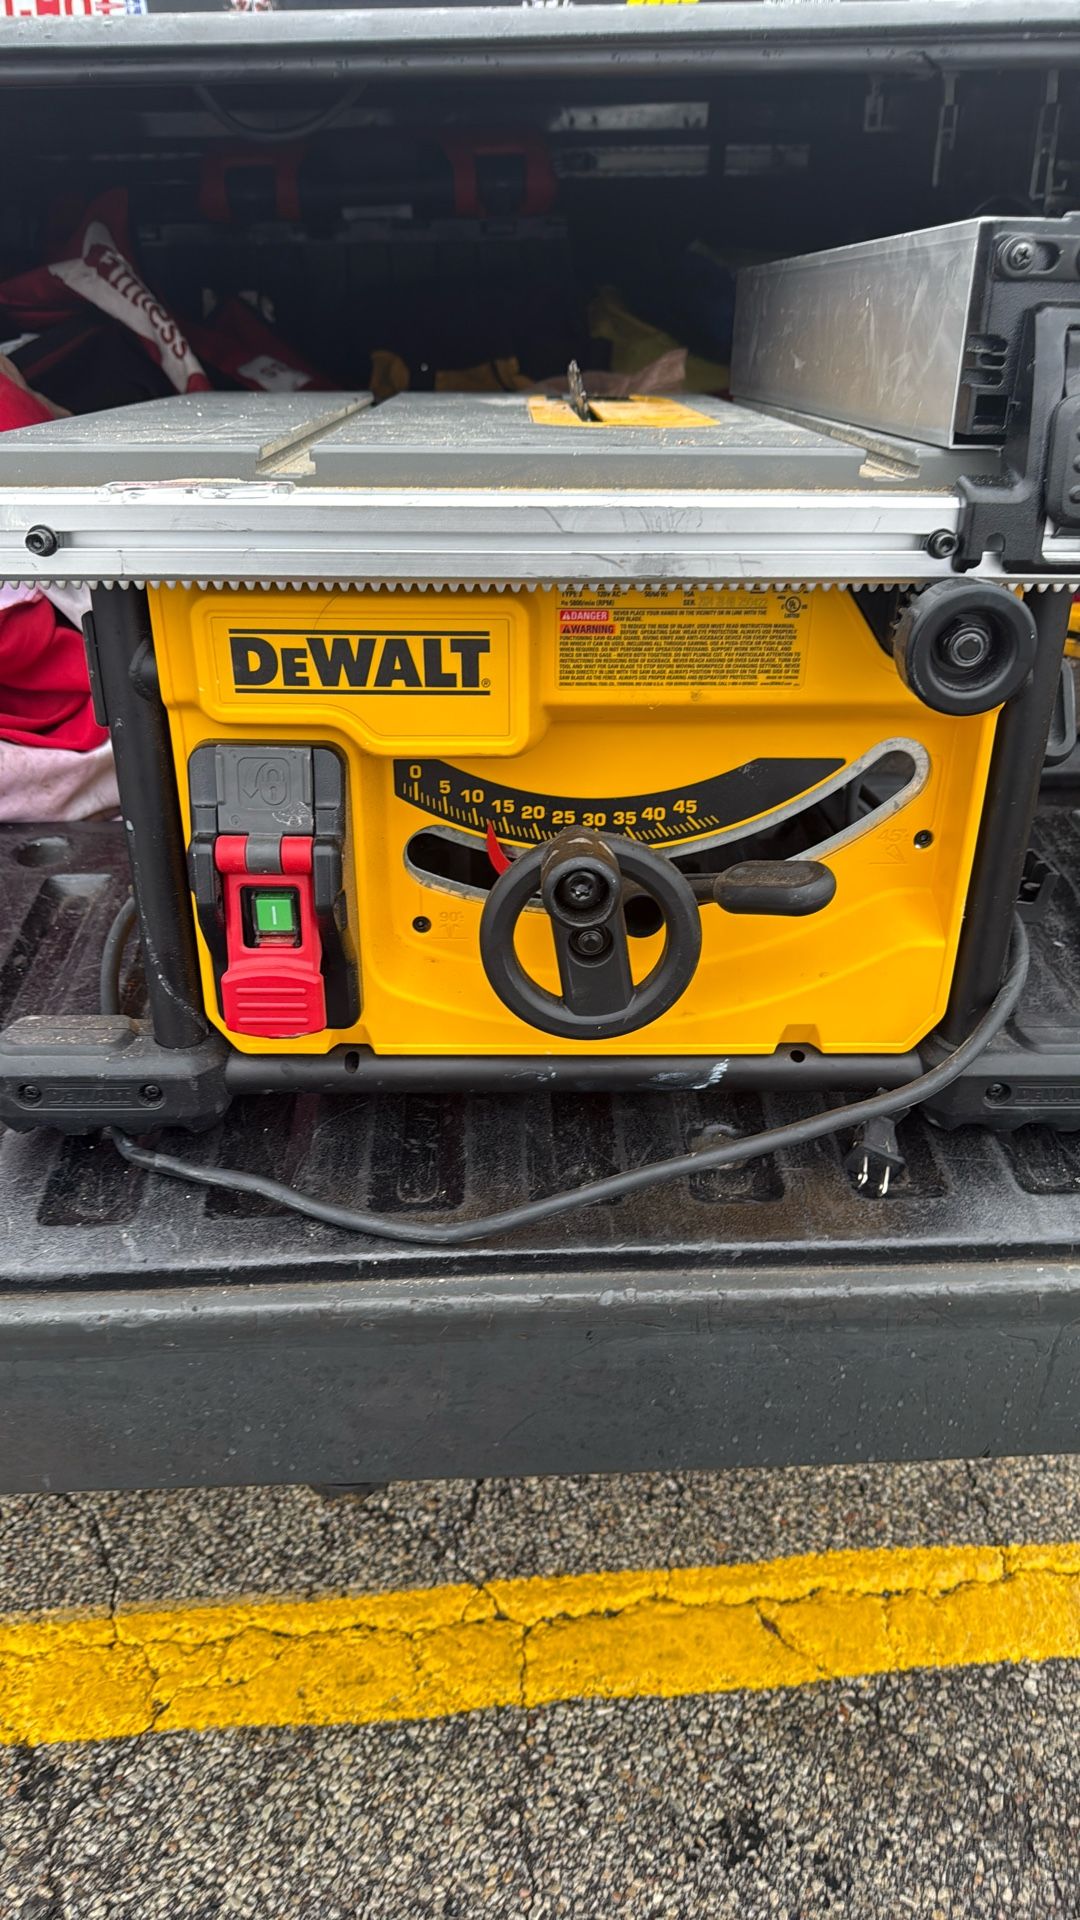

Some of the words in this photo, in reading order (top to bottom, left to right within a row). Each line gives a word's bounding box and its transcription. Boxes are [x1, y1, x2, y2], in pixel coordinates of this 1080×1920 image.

[570, 611, 607, 620] DANGER
[571, 625, 614, 634] WARNING
[409, 765, 422, 779] 0
[440, 780, 451, 794] 5
[461, 789, 484, 803] 10
[492, 800, 515, 813] 15
[521, 806, 545, 819] 20
[552, 810, 576, 824] 25
[582, 813, 606, 826] 30
[613, 811, 637, 825] 35
[641, 807, 666, 821] 40
[673, 800, 697, 814] 45
